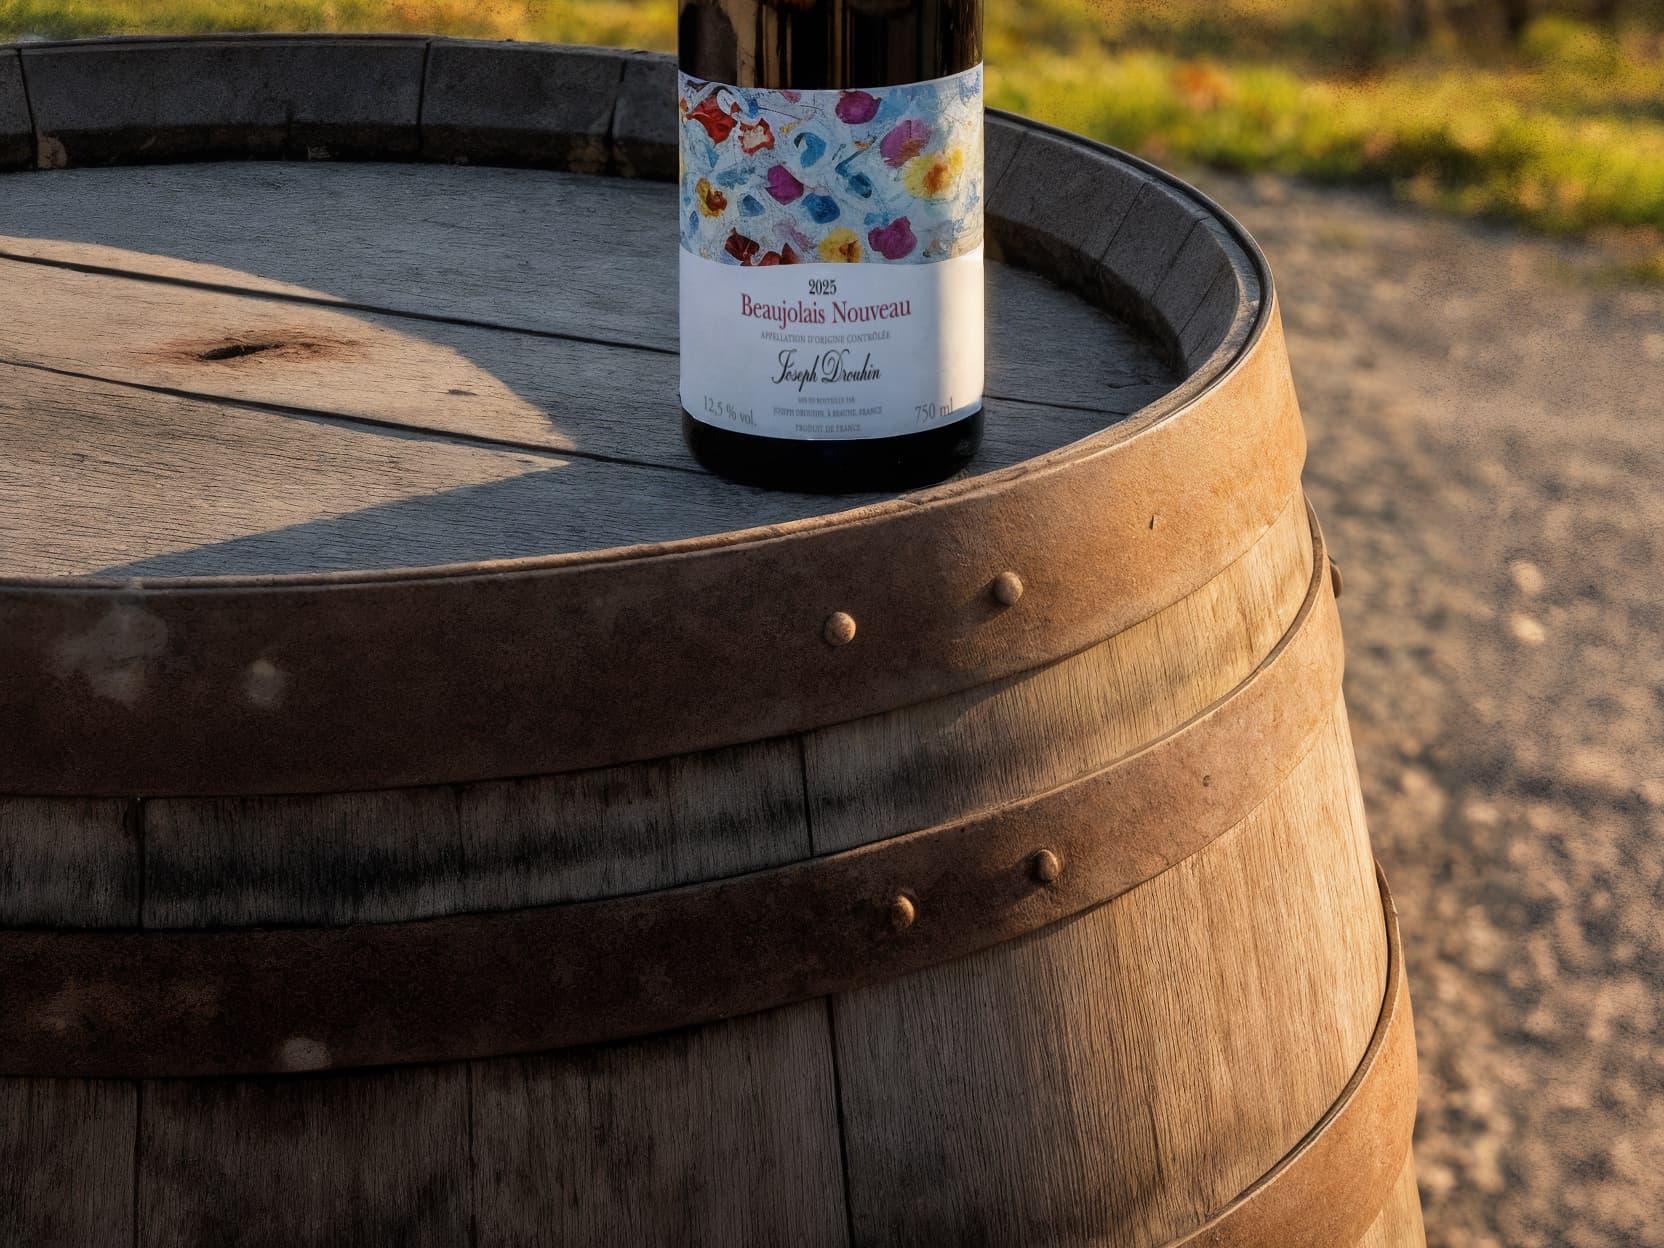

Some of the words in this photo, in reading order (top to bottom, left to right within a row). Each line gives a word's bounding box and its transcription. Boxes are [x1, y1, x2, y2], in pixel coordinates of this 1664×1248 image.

[808, 279, 837, 295] 2025
[741, 293, 825, 329] Beaujolais
[832, 300, 911, 324] Nouveau
[760, 331, 806, 344] APPELLATION
[771, 349, 819, 392] Joseph
[821, 349, 880, 383] Drouhin
[914, 402, 936, 424] 750
